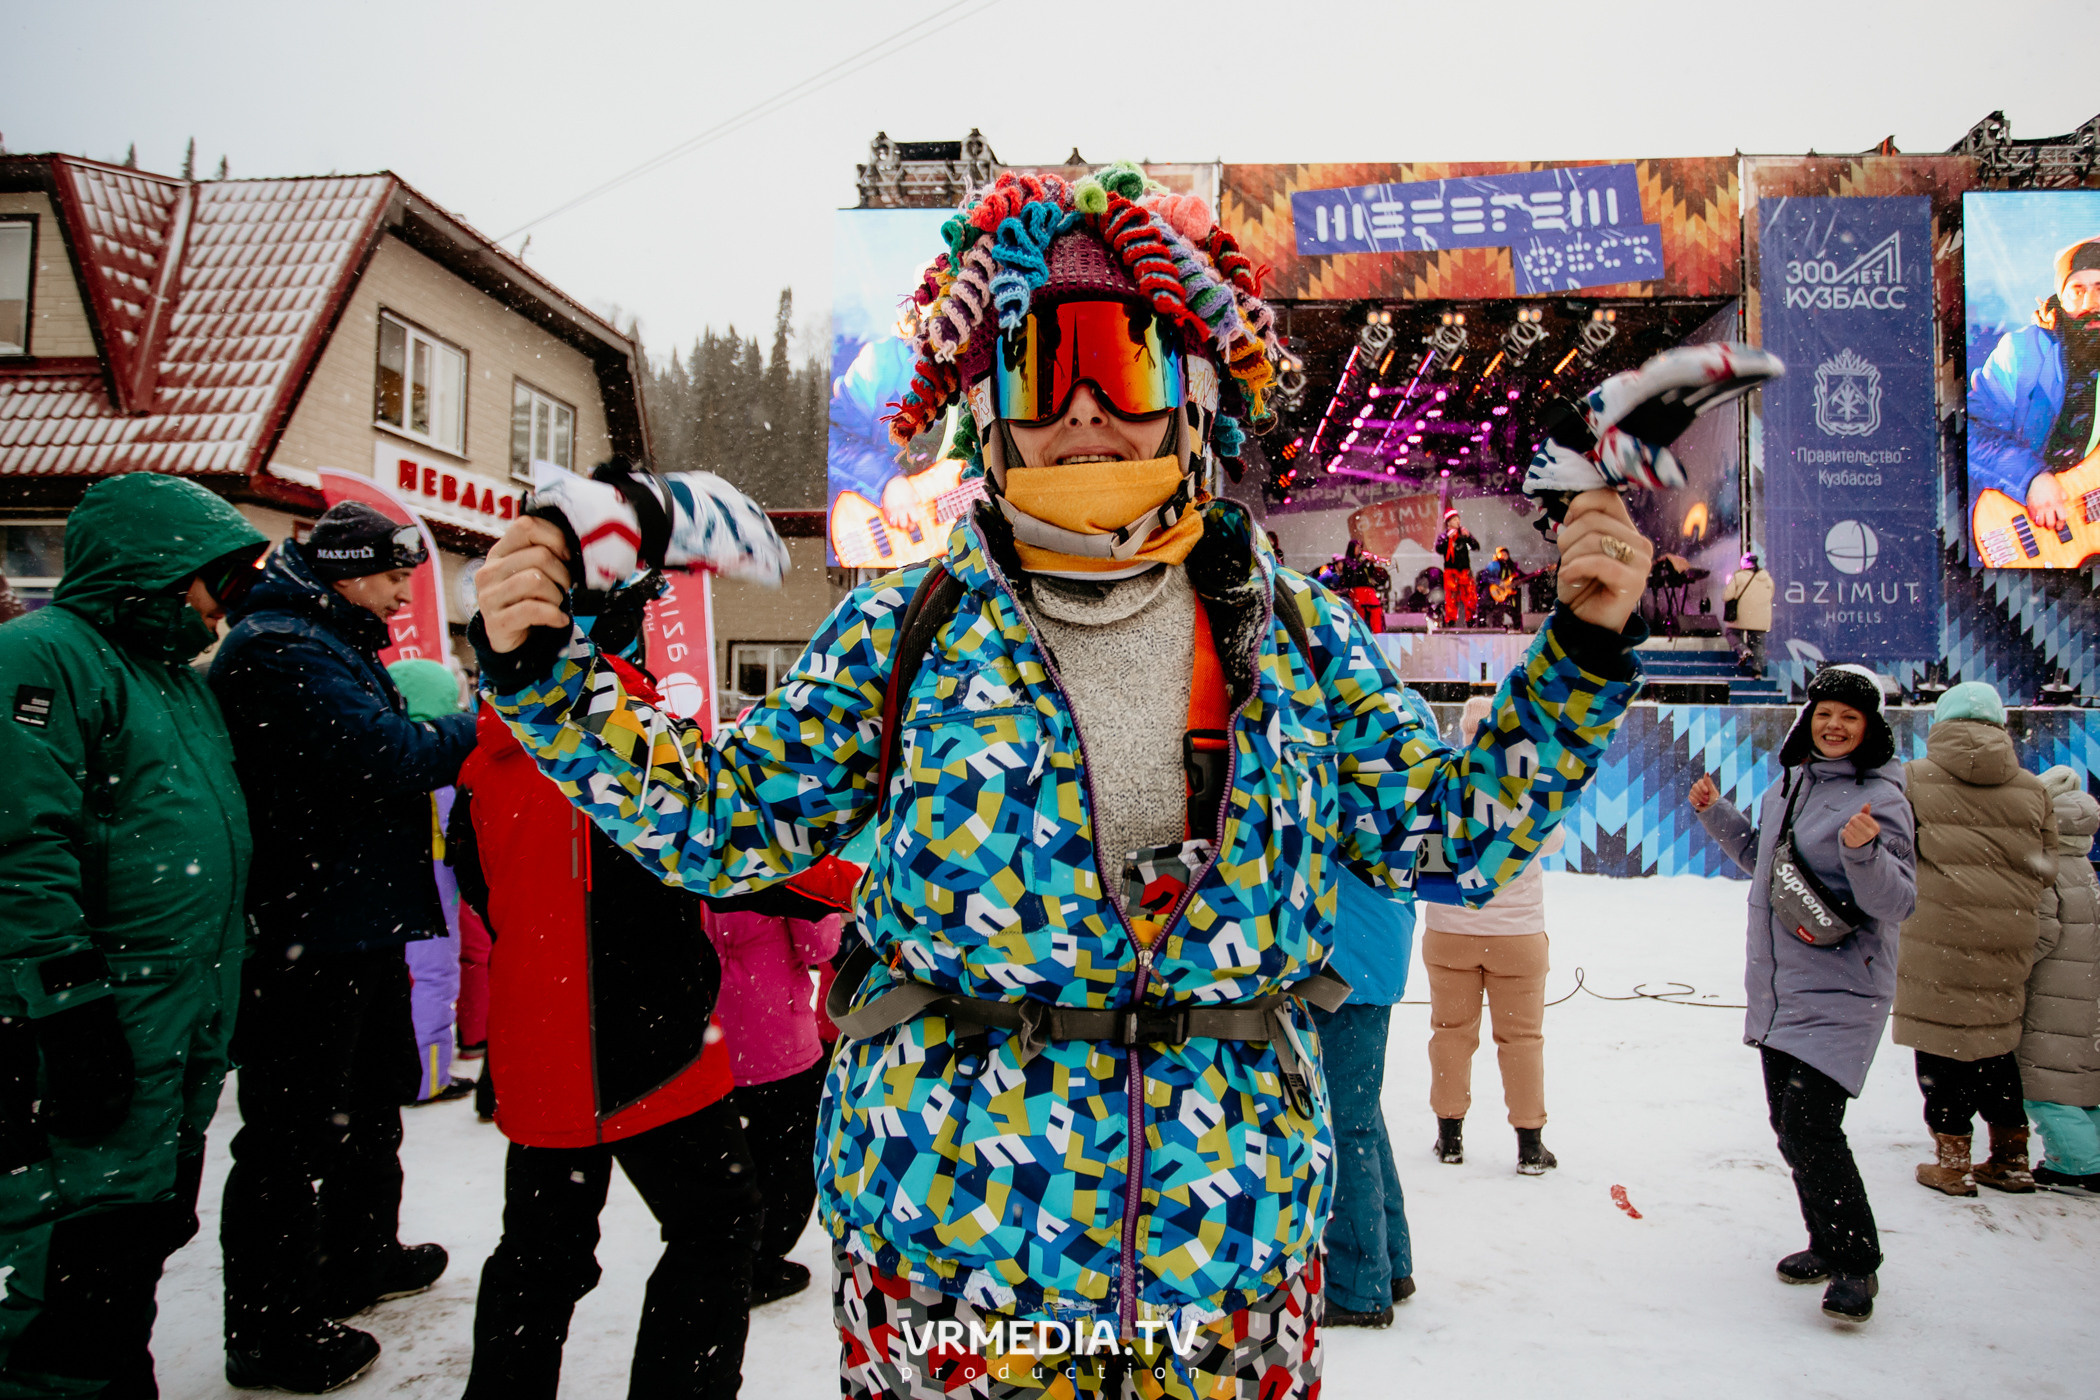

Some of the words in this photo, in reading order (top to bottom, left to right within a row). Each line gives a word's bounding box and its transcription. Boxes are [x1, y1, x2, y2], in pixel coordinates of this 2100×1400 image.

[1524, 235, 1651, 285] ФЕСТ
[1785, 260, 1838, 285] 300
[1785, 286, 1907, 310] КУЗБАСС
[1797, 447, 1902, 465] Правительство
[398, 459, 521, 520] НЕВАЛЯ
[1818, 469, 1882, 488] Кузбасса
[1825, 610, 1882, 624] HOTELS
[1776, 863, 1833, 927] Supreme
